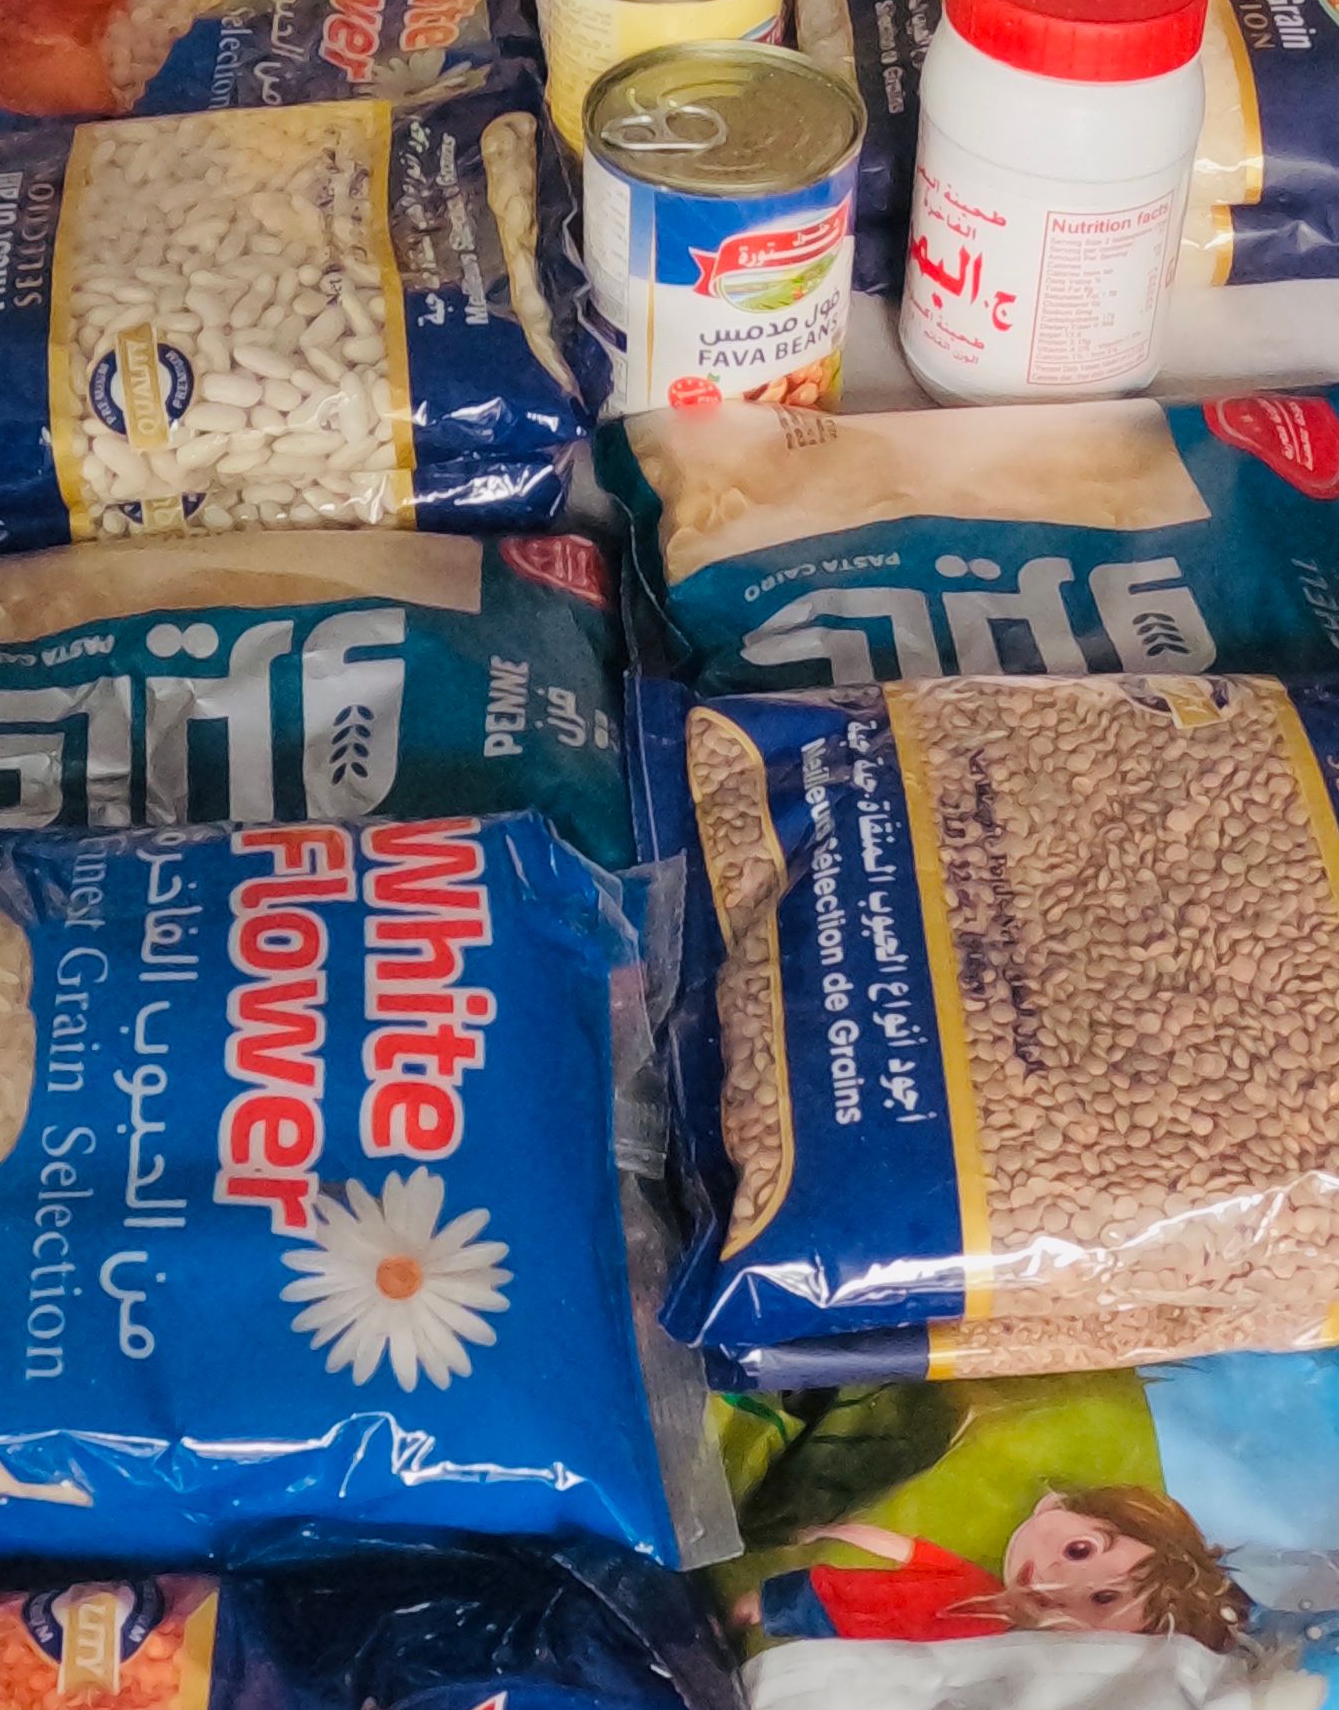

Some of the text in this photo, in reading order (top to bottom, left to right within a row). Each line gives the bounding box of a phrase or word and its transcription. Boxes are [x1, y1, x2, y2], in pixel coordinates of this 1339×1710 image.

[1052, 202, 1169, 236] Nutrition facts
[698, 314, 839, 369] FAVA BEANS
[699, 316, 799, 346] مدمس
[742, 551, 902, 603] PASTA CAIRO
[42, 632, 116, 668] PASTA
[483, 654, 531, 759] PENNE
[855, 889, 910, 974] الحبوب
[47, 945, 110, 1094] Grain
[360, 816, 495, 1160] White
[822, 972, 855, 1012] de
[867, 980, 929, 1047] أنواع
[212, 826, 357, 1238] Flower
[825, 1019, 865, 1126] Grains
[114, 1000, 188, 1230] الحبوب
[879, 1056, 938, 1125] أجود
[24, 1122, 97, 1381] Selection
[99, 1248, 166, 1359] من
